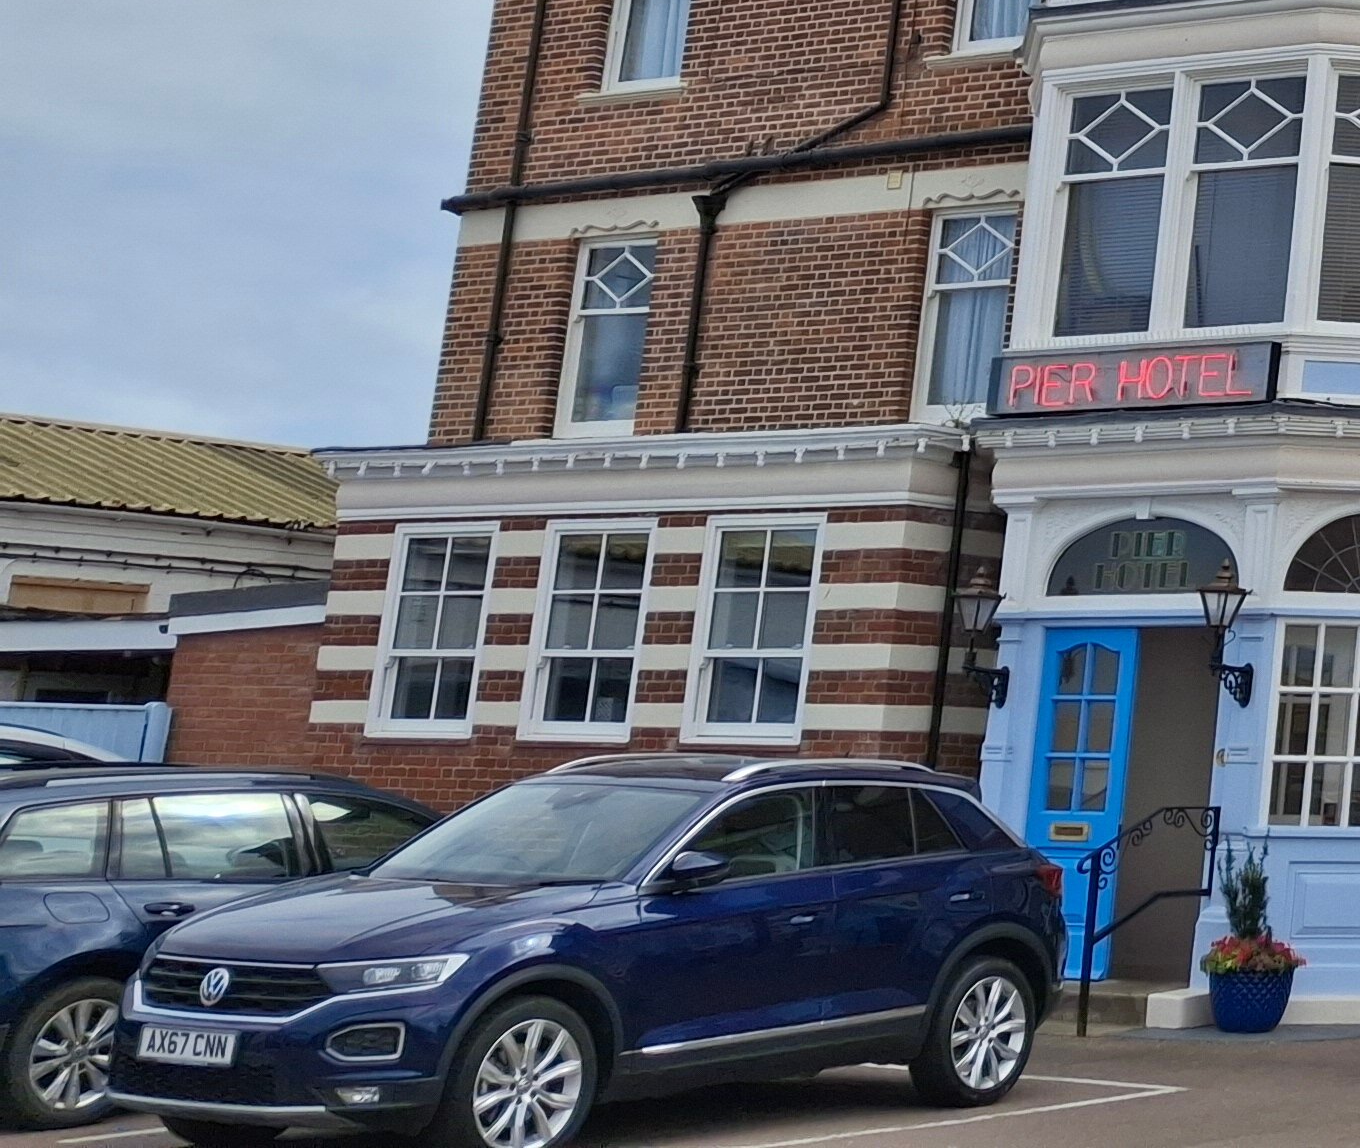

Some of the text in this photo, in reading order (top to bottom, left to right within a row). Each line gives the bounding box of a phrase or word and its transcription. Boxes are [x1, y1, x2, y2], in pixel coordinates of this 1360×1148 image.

[1009, 352, 1252, 408] PIER HOTEL
[146, 1030, 229, 1059] AX67 CNN
